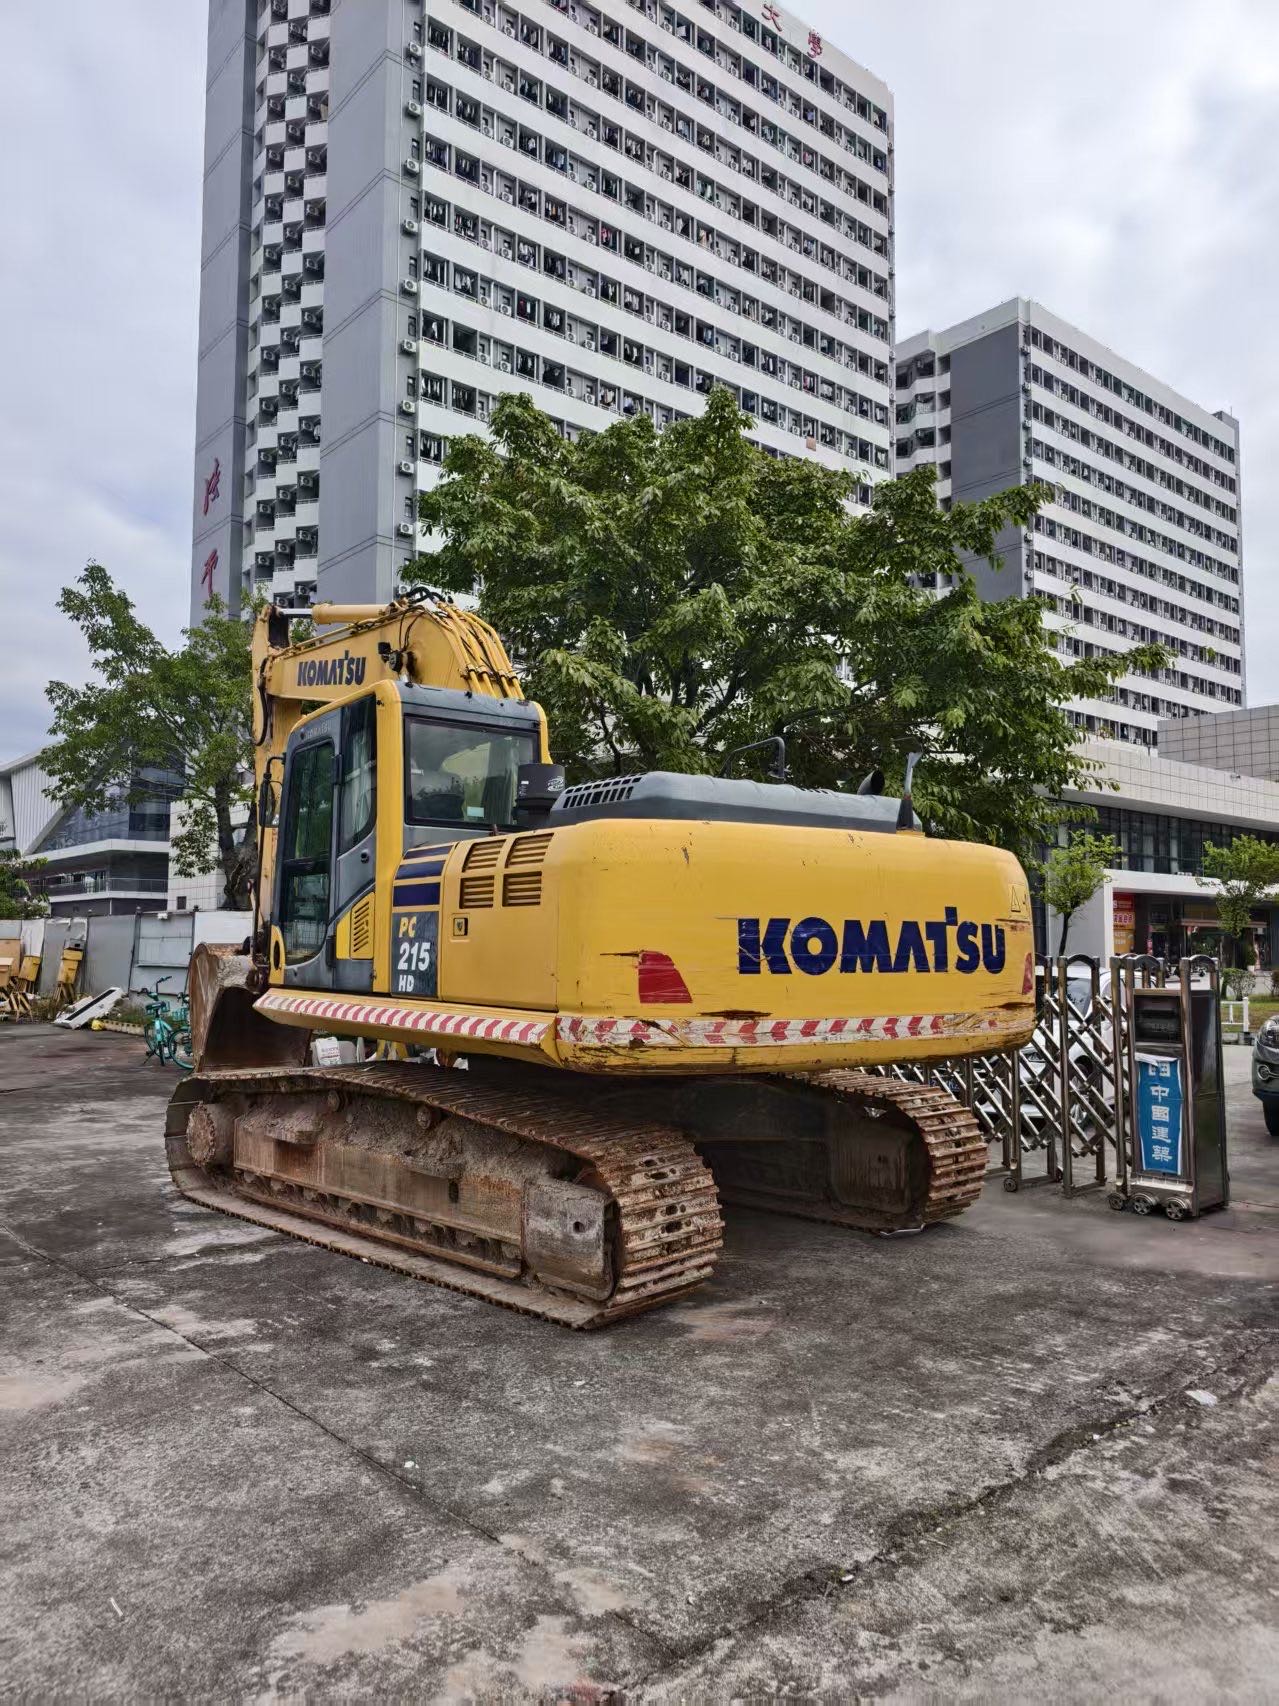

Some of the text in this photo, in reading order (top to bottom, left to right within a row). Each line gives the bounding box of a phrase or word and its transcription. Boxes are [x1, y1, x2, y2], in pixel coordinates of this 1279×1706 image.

[297, 650, 367, 687] KOMATSU
[398, 916, 417, 938] PC
[737, 906, 1006, 976] KOMATSU
[397, 942, 431, 971] 215
[398, 974, 415, 992] HD
